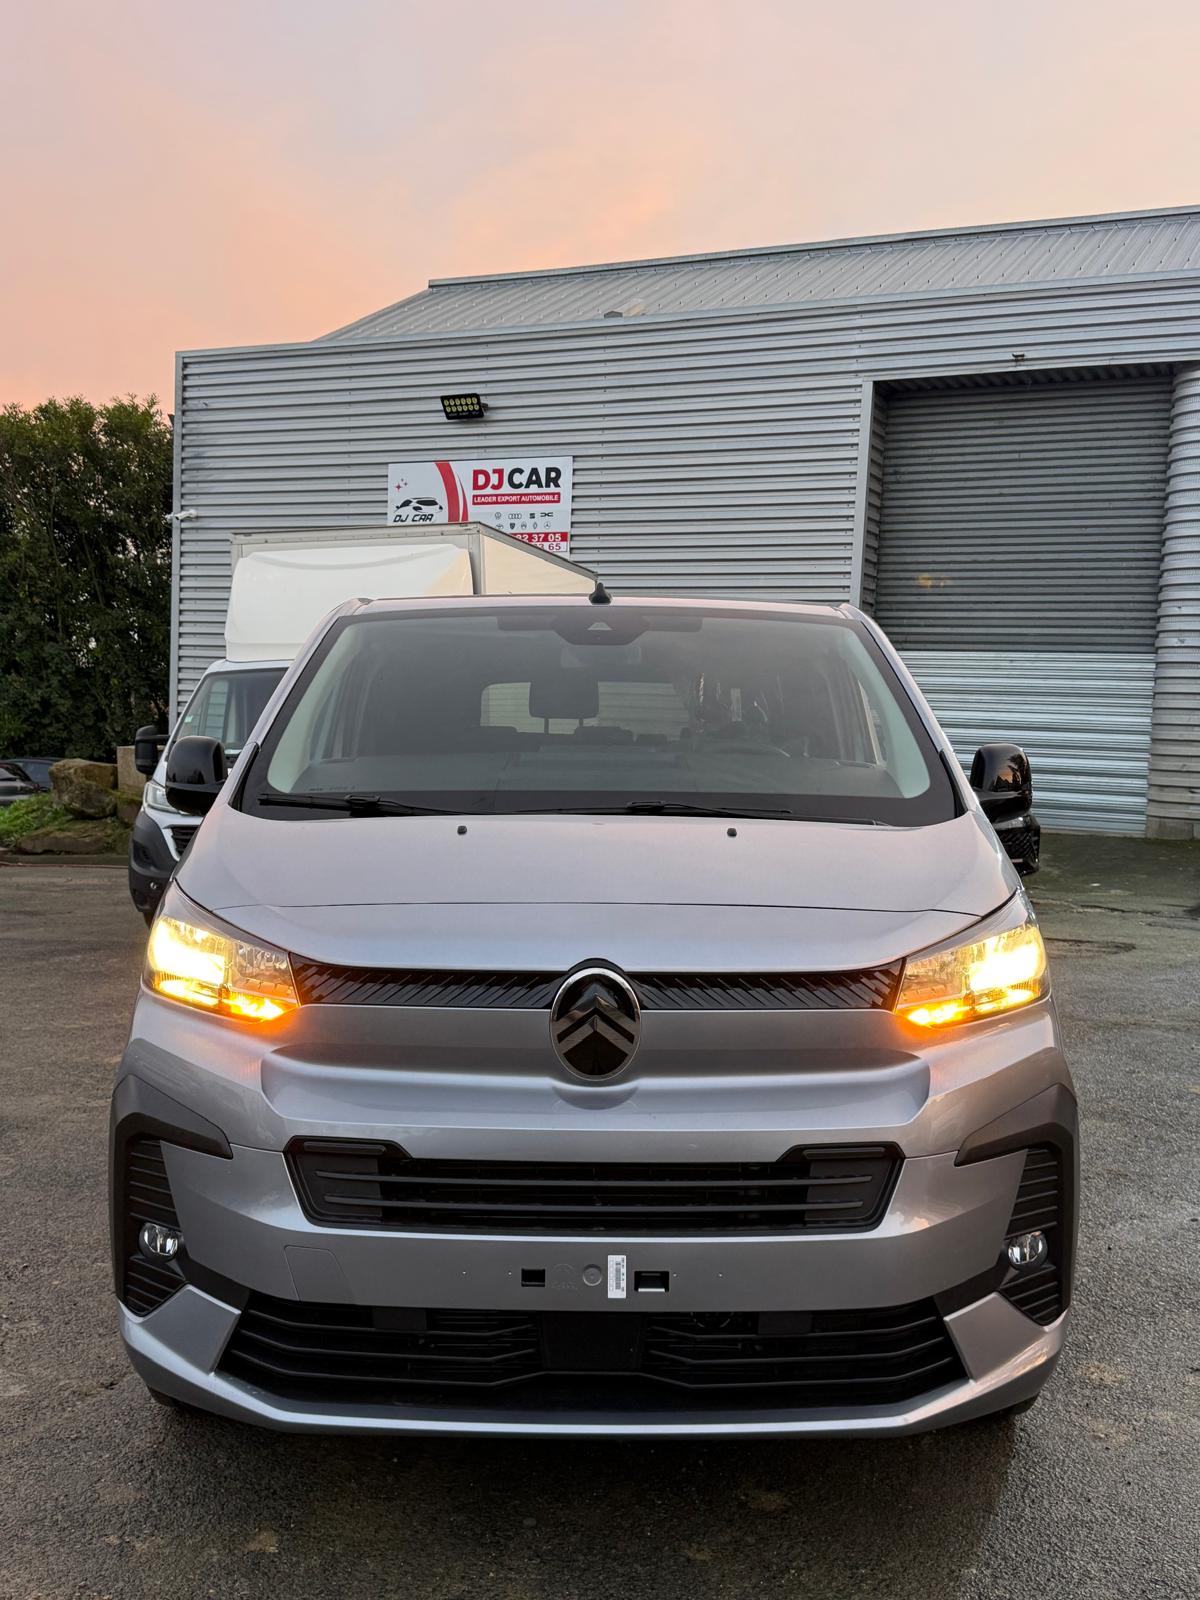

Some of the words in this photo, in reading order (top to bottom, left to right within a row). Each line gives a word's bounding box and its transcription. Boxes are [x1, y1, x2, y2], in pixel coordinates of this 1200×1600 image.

[472, 468, 504, 491] DJ
[507, 467, 562, 489] CAR
[521, 494, 559, 502] AUTOMOBILE
[393, 514, 410, 522] DJ
[411, 513, 434, 522] CAR
[531, 533, 545, 542] 37
[547, 533, 562, 542] 05
[548, 543, 561, 551] 65
